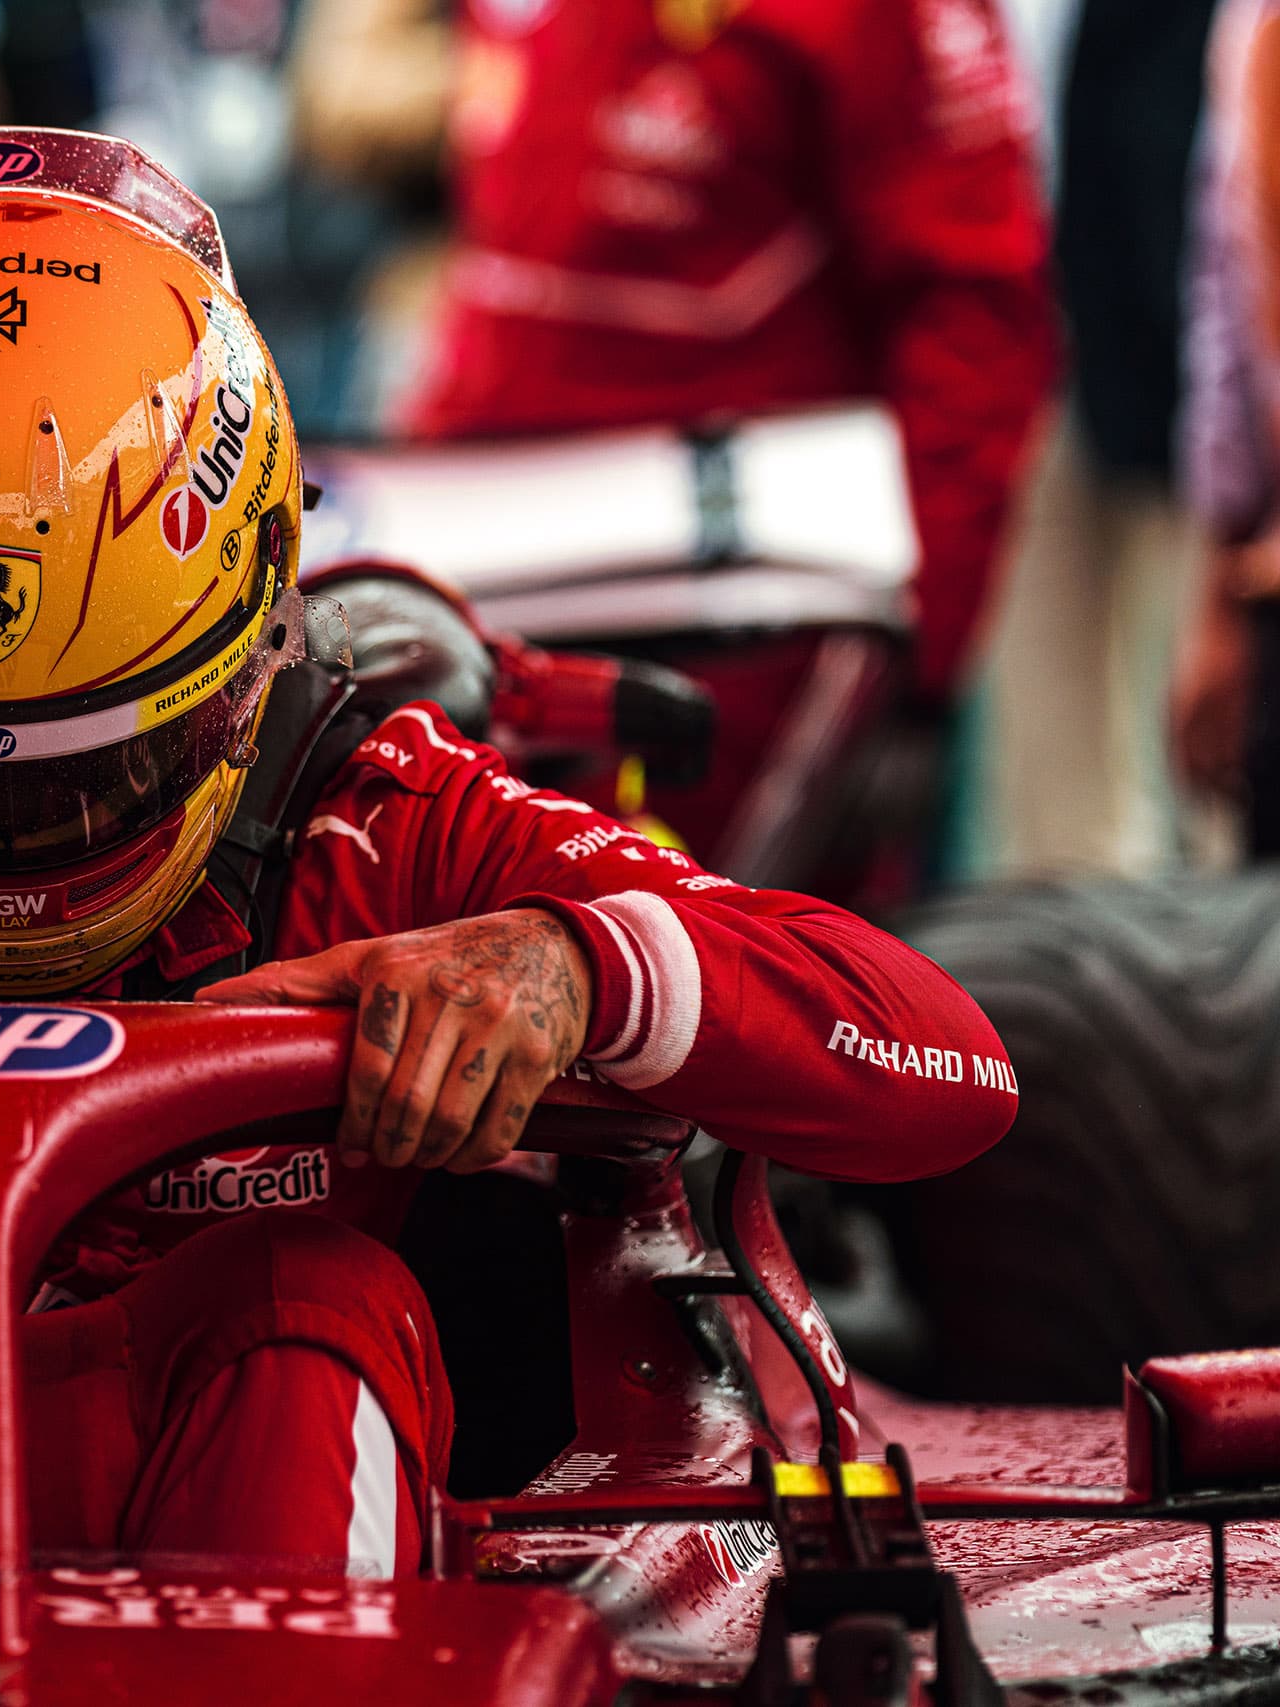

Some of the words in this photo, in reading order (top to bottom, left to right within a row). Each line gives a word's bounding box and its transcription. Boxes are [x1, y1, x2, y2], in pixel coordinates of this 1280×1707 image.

[193, 299, 252, 505] UniCredit
[155, 668, 220, 713] RICHARD
[222, 633, 254, 673] MILLE
[144, 1152, 327, 1210] UniCredit
